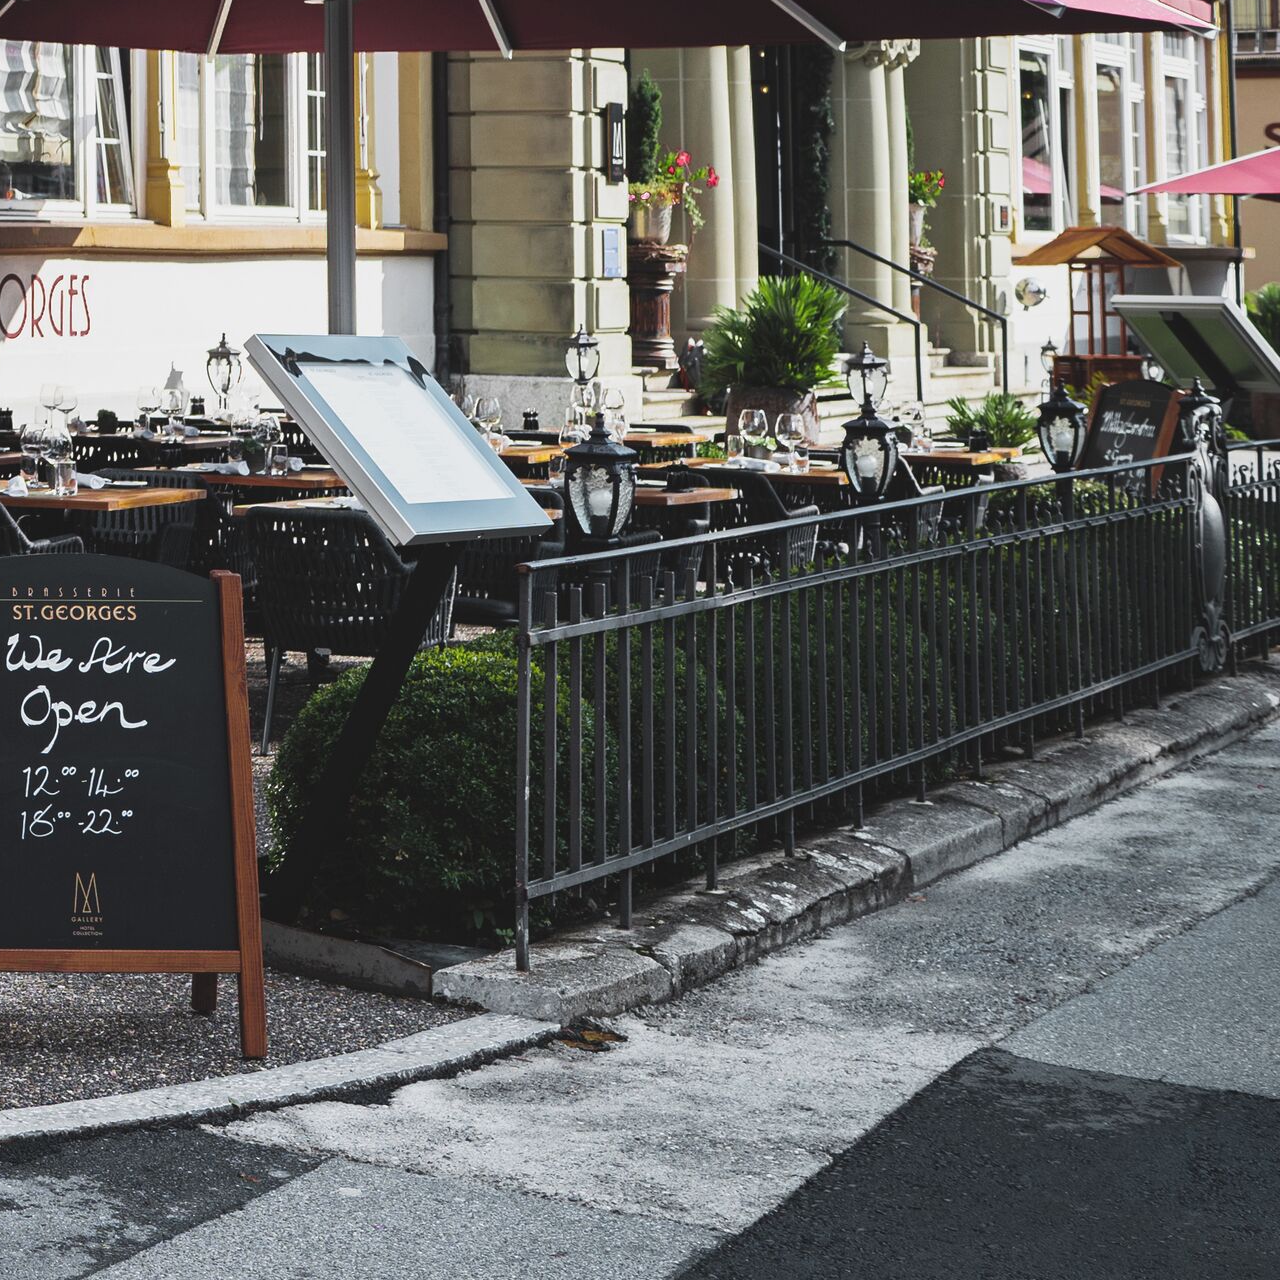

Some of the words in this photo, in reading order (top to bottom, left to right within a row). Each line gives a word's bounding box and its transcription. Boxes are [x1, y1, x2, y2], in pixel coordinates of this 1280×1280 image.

[12, 586, 135, 598] BRASSERIE
[5, 632, 73, 673] We
[78, 635, 176, 674] Are
[21, 684, 148, 754] Open
